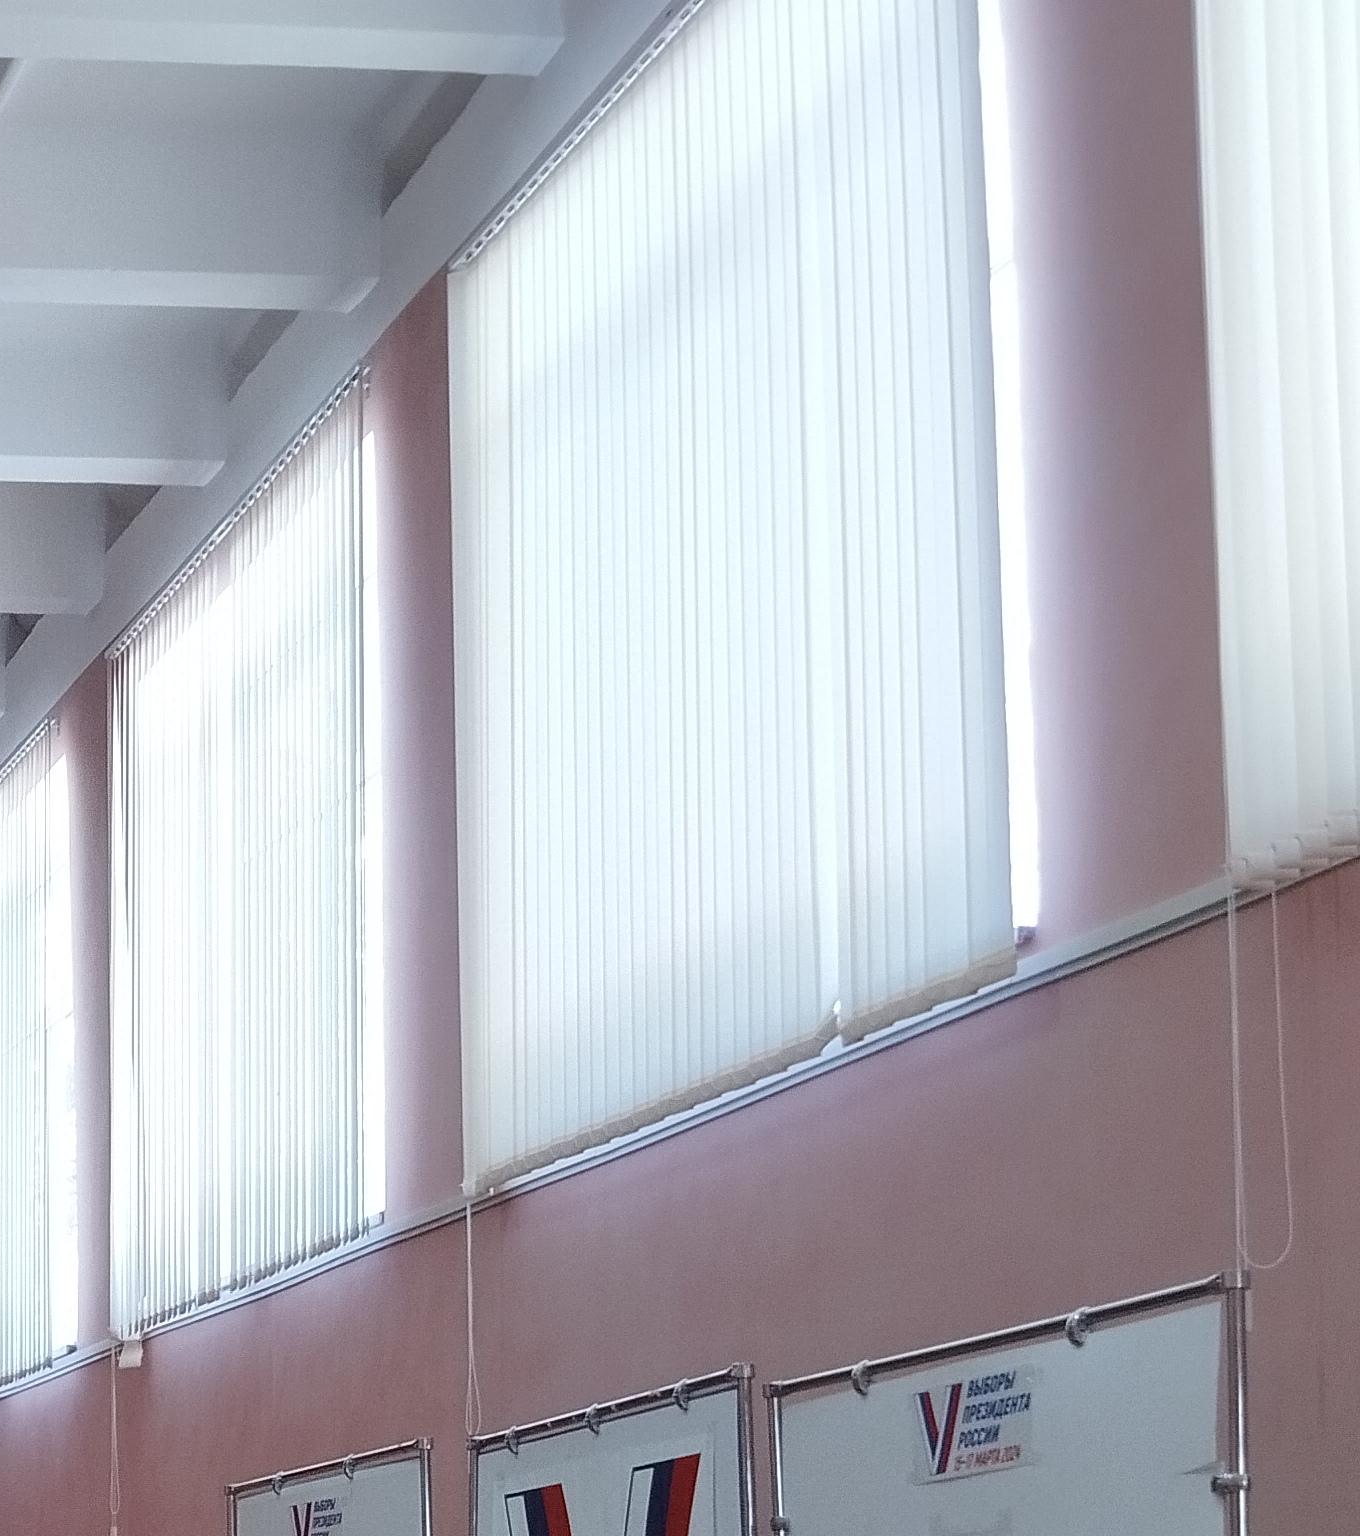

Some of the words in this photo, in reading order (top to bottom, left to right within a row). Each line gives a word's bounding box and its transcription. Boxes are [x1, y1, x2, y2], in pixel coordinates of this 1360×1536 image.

[966, 1370, 1017, 1398] ВЫБОРЫ
[961, 1392, 1031, 1423] ПРЕЗИДЕНТА
[957, 1423, 1000, 1450] РОССИИ
